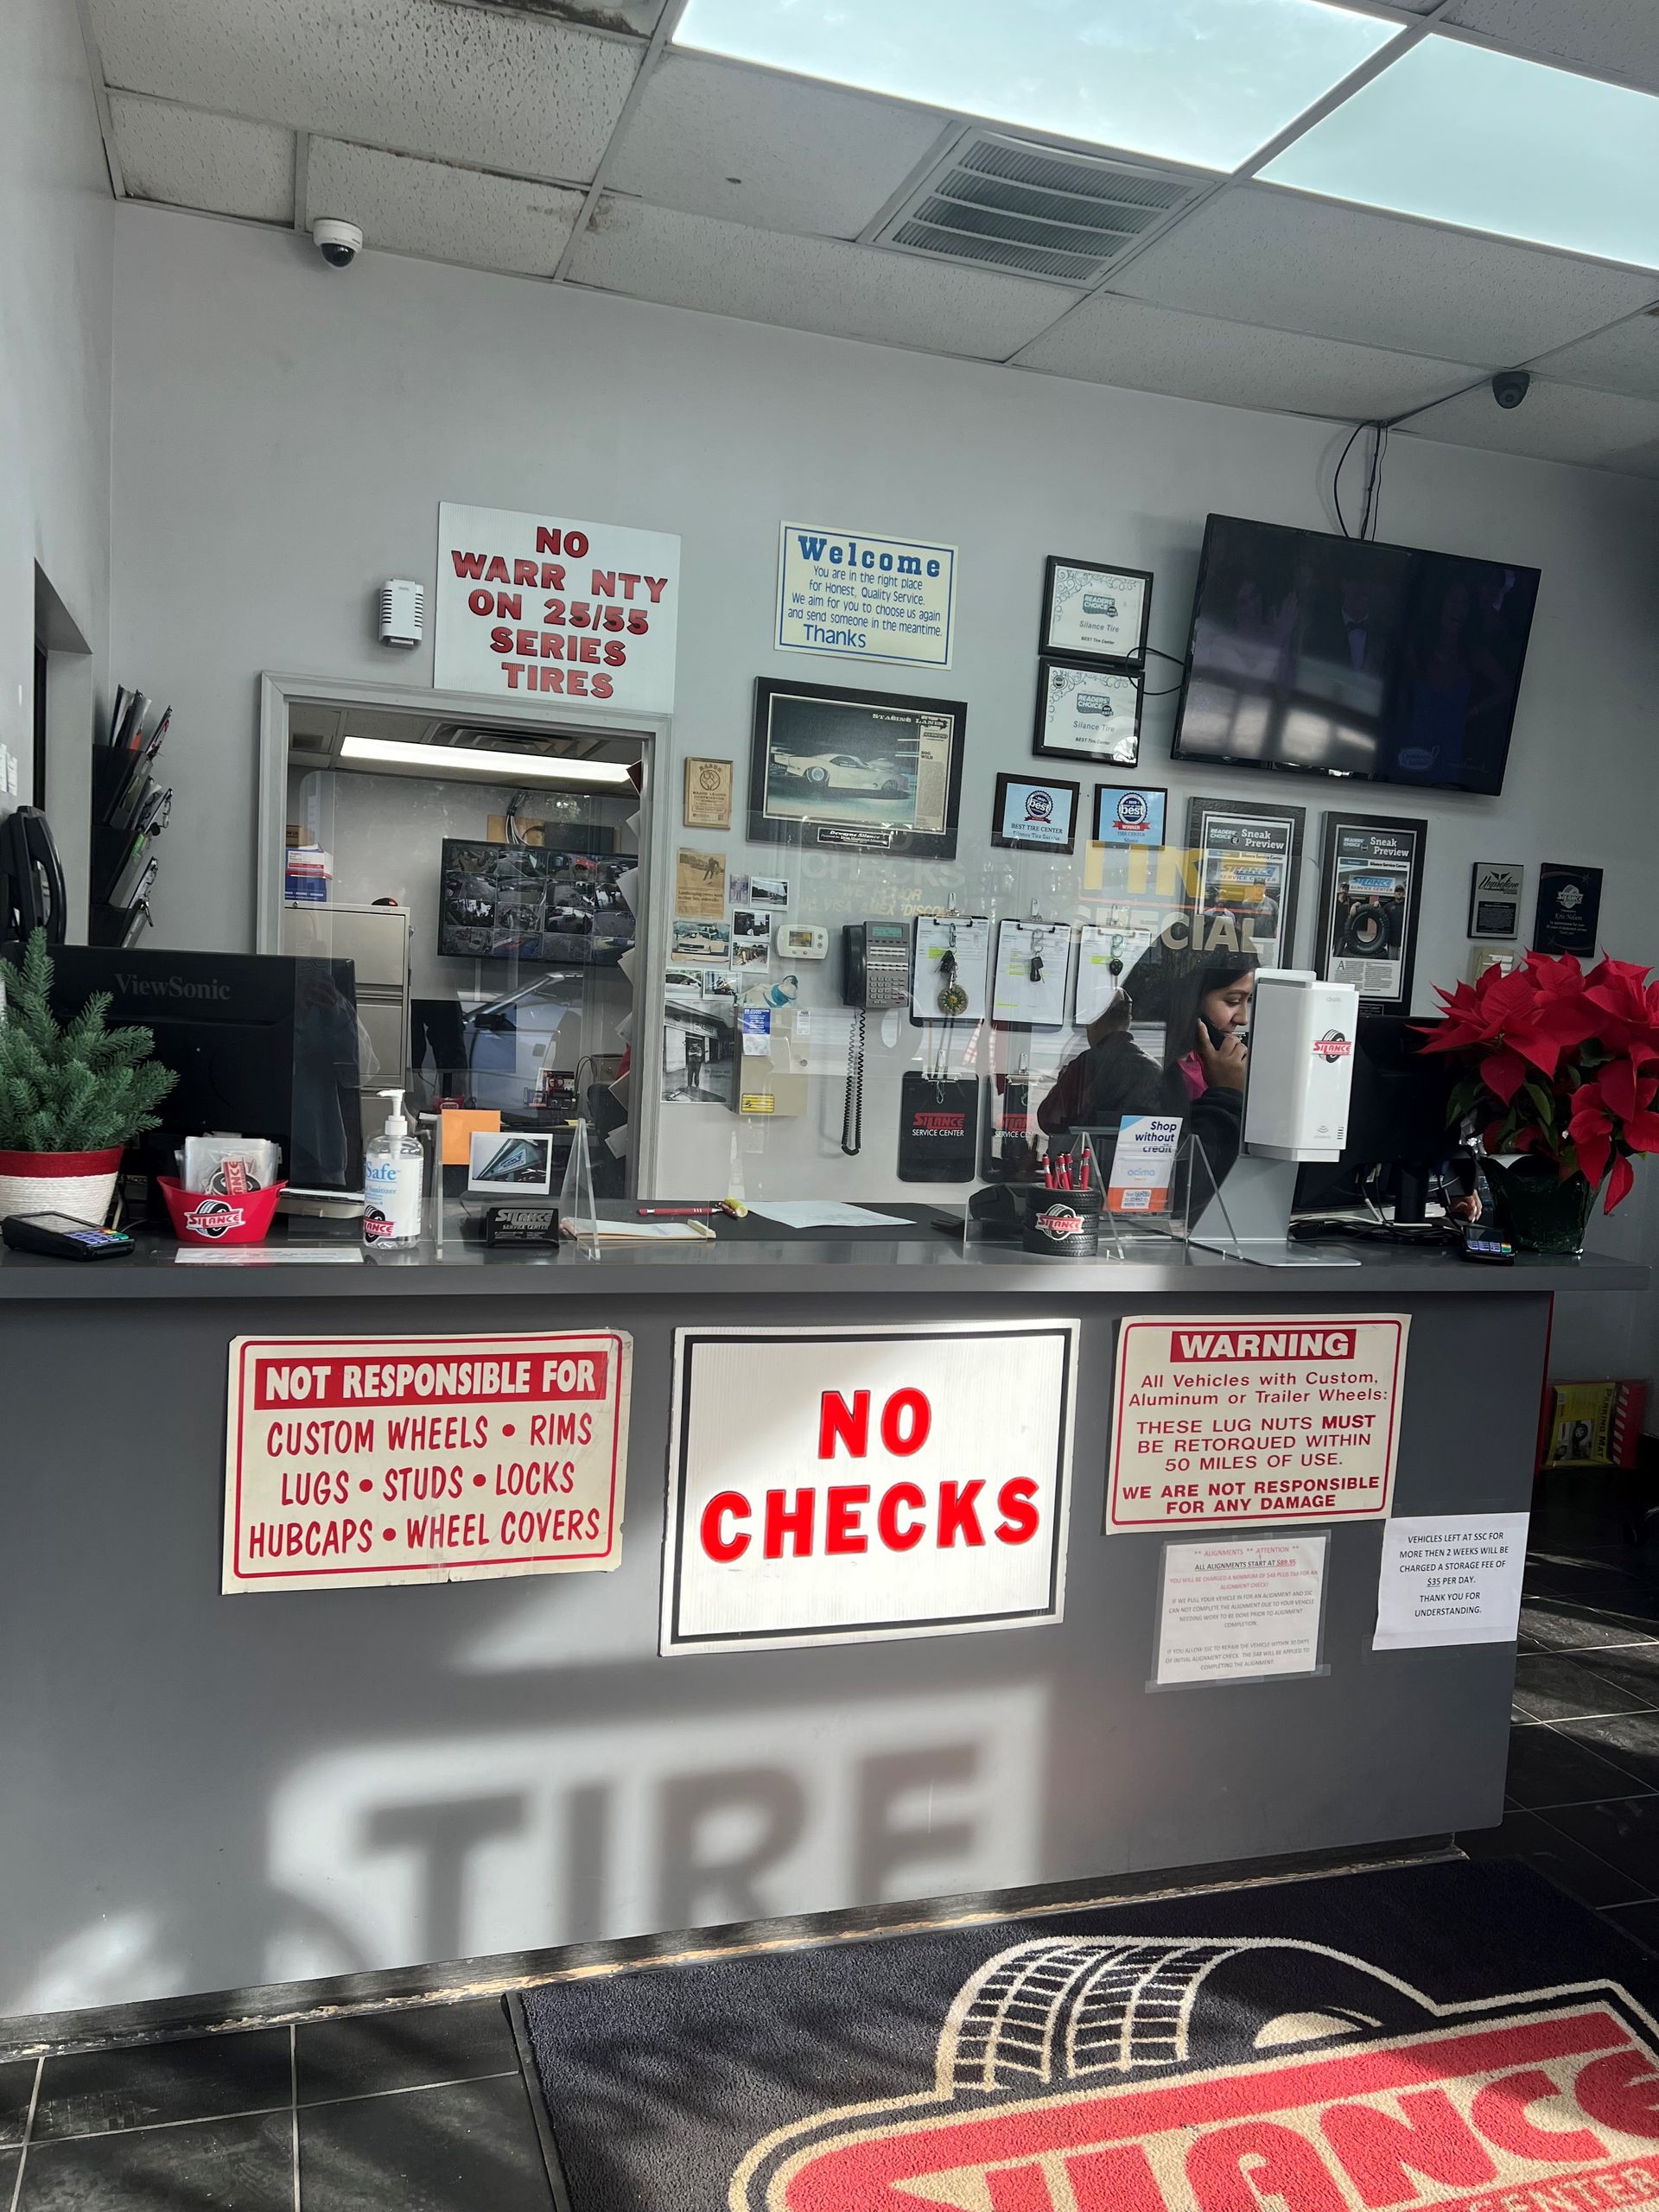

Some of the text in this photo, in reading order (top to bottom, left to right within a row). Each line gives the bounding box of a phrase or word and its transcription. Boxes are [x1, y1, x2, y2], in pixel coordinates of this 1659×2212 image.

[536, 526, 589, 558] NO
[798, 535, 940, 577] Welcome
[814, 565, 923, 590] You are in the right place
[810, 580, 925, 605] for Honest, Quality Service.
[468, 588, 649, 635] ON 25/55
[792, 593, 940, 622] We aim for you to choose us again
[788, 608, 942, 636] and send someone in the meantime.
[1079, 620, 1120, 632] Silance Tire
[804, 624, 866, 648] Thanks
[490, 626, 626, 666] SERIES
[501, 662, 613, 698] TIRES
[872, 713, 912, 722] STAGING
[1073, 721, 1115, 733] Silance Tire
[1029, 798, 1050, 811] best
[1121, 804, 1144, 815] best
[1242, 830, 1271, 839] Sneak
[1245, 838, 1284, 849] Preview
[1370, 837, 1396, 847] Sneak
[1374, 847, 1409, 856] Preview
[114, 973, 231, 1000] ViewSonic
[1313, 1041, 1351, 1055] SILANCE
[913, 1113, 965, 1130] SILANCE
[1150, 1122, 1176, 1133] Shop
[1135, 1132, 1174, 1141] without
[1143, 1144, 1172, 1153] credit
[189, 1214, 240, 1230] SILANCE
[495, 1210, 554, 1225] SILANCE
[1038, 1217, 1081, 1231] SILANCE
[1179, 1333, 1349, 1358] WARNING
[265, 1360, 595, 1401] NOT RESPONSIBLE FOR
[1141, 1372, 1378, 1388] All Vehicles with Custom,
[1128, 1389, 1388, 1407] Aluminum or Trailer Wheels:
[818, 1387, 931, 1459] NO
[1137, 1415, 1376, 1434] THESE LUG NUTS MUST
[267, 1413, 593, 1458] CUSTOM WHEELS RIMS
[1138, 1434, 1371, 1453] BE RETORQUED WITHIN
[1165, 1453, 1343, 1471] 50 MILES OF USE.
[281, 1461, 574, 1506] LUGS STUDS LOCKS
[1123, 1476, 1380, 1499] WE ARE NOT RESPONSIBLE
[1166, 1495, 1336, 1514] FOR ANY DAMAGE
[700, 1476, 1039, 1564] CHECKS
[250, 1508, 600, 1559] HUBCAPS WHEEL COVERS
[1408, 1535, 1442, 1544] VEHICLES
[1445, 1534, 1460, 1542] LEFT
[1400, 1564, 1436, 1573] CHARGED
[1420, 1594, 1446, 1603] THANK
[1414, 1606, 1481, 1617] UNDERSTANDING.
